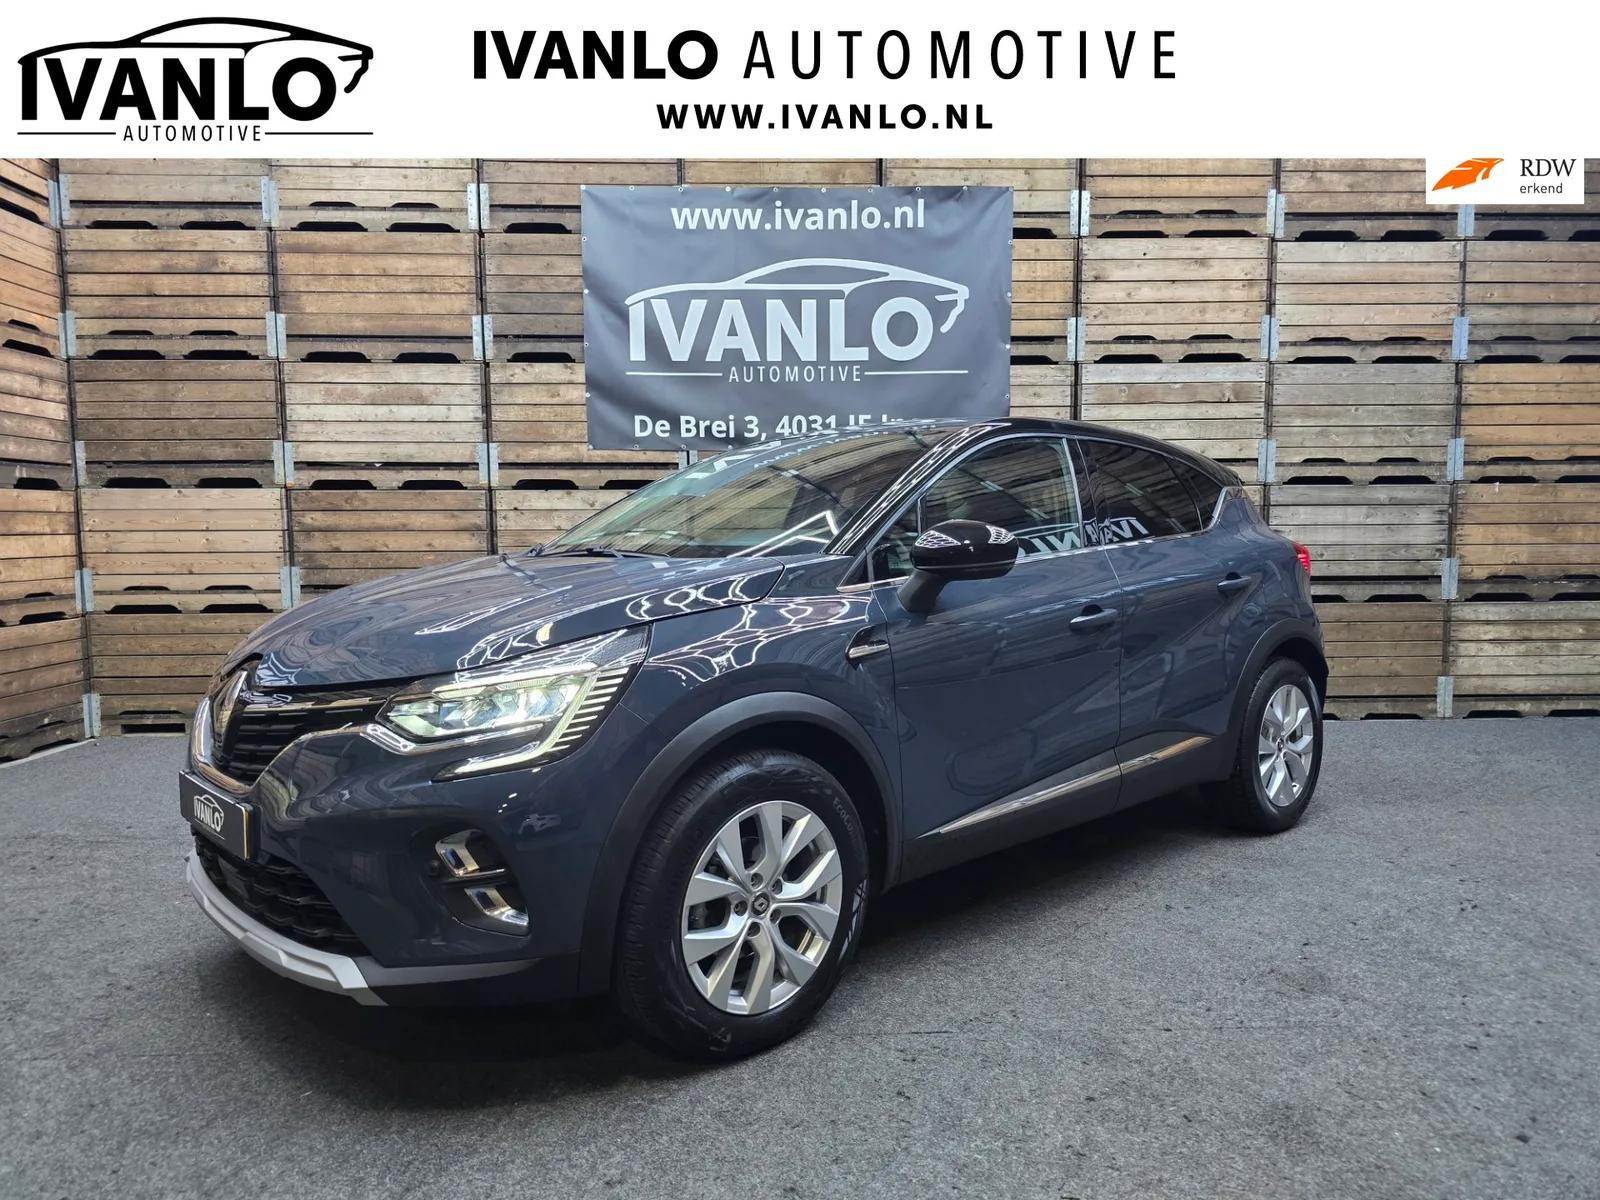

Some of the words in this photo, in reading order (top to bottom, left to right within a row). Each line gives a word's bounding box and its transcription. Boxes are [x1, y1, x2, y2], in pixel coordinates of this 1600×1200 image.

[671, 199, 925, 230] www.ivanlo.nl
[628, 296, 934, 362] IVANLO
[728, 366, 862, 383] AUTOMOTIVE
[634, 415, 671, 437] De
[680, 414, 736, 438] Brei
[743, 415, 767, 442] 3,
[194, 798, 221, 832] IVANLO
